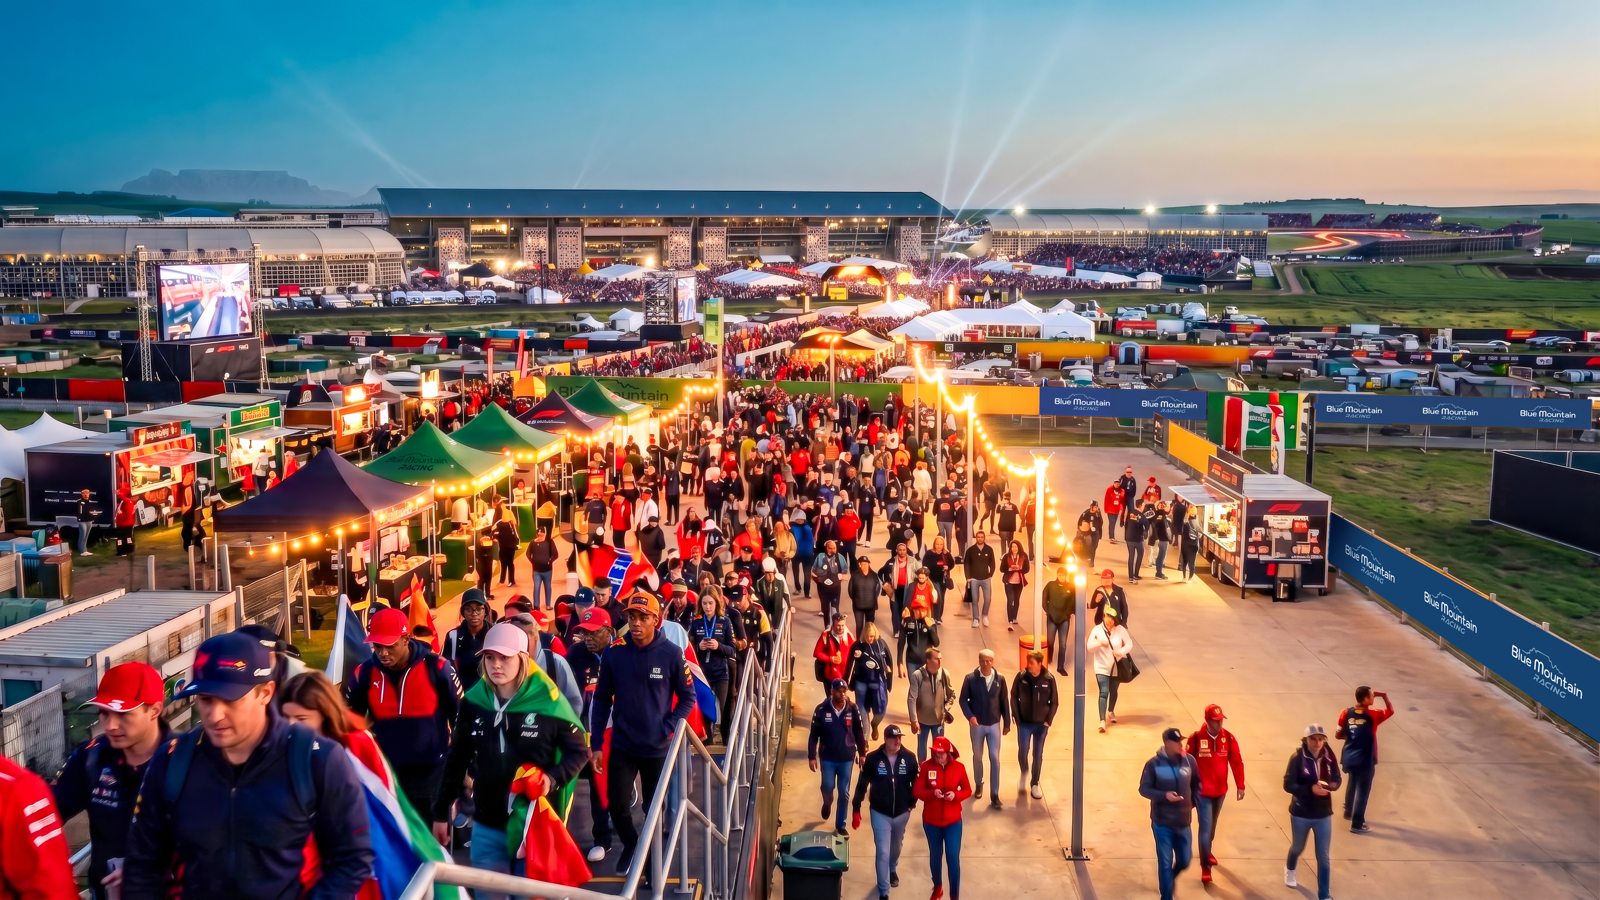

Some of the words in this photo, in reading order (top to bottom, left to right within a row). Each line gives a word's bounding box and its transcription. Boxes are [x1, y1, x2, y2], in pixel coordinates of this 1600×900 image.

[1054, 397, 1071, 405] Blue
[1073, 398, 1110, 406] Mountain
[1141, 399, 1158, 407] Blue
[1160, 400, 1198, 409] Mountain
[1345, 405, 1382, 414] Mountain
[1422, 407, 1439, 415] Blue
[1441, 407, 1478, 416] Mountain
[1520, 409, 1537, 417] Blue
[1538, 410, 1576, 418] Mountain
[1344, 544, 1360, 562] Blue
[1360, 554, 1396, 584] Mountain
[1360, 566, 1384, 585] RACING
[1423, 590, 1440, 610] Blue
[1440, 601, 1478, 634] Mountain
[1440, 614, 1466, 635] RACING
[1511, 644, 1532, 667] Blue
[1533, 658, 1583, 700] Mountain
[1533, 673, 1567, 699] RACING
